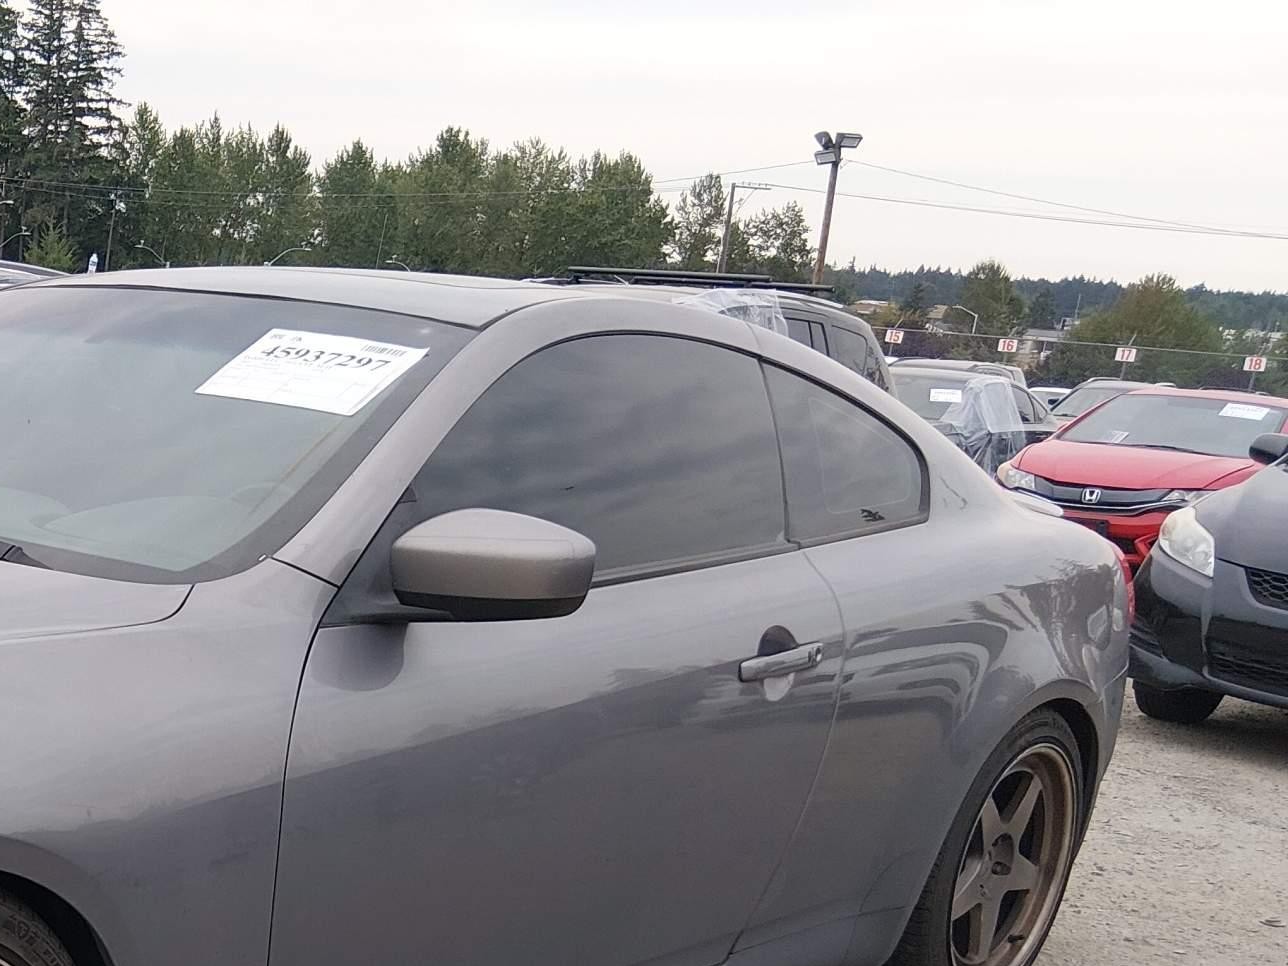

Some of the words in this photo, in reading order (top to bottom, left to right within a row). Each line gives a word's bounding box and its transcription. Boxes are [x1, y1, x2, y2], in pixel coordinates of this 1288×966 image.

[888, 331, 900, 342] 15
[1002, 341, 1014, 352] 16
[261, 344, 392, 372] 45937297
[1120, 349, 1131, 361] 17
[1248, 358, 1262, 371] 18
